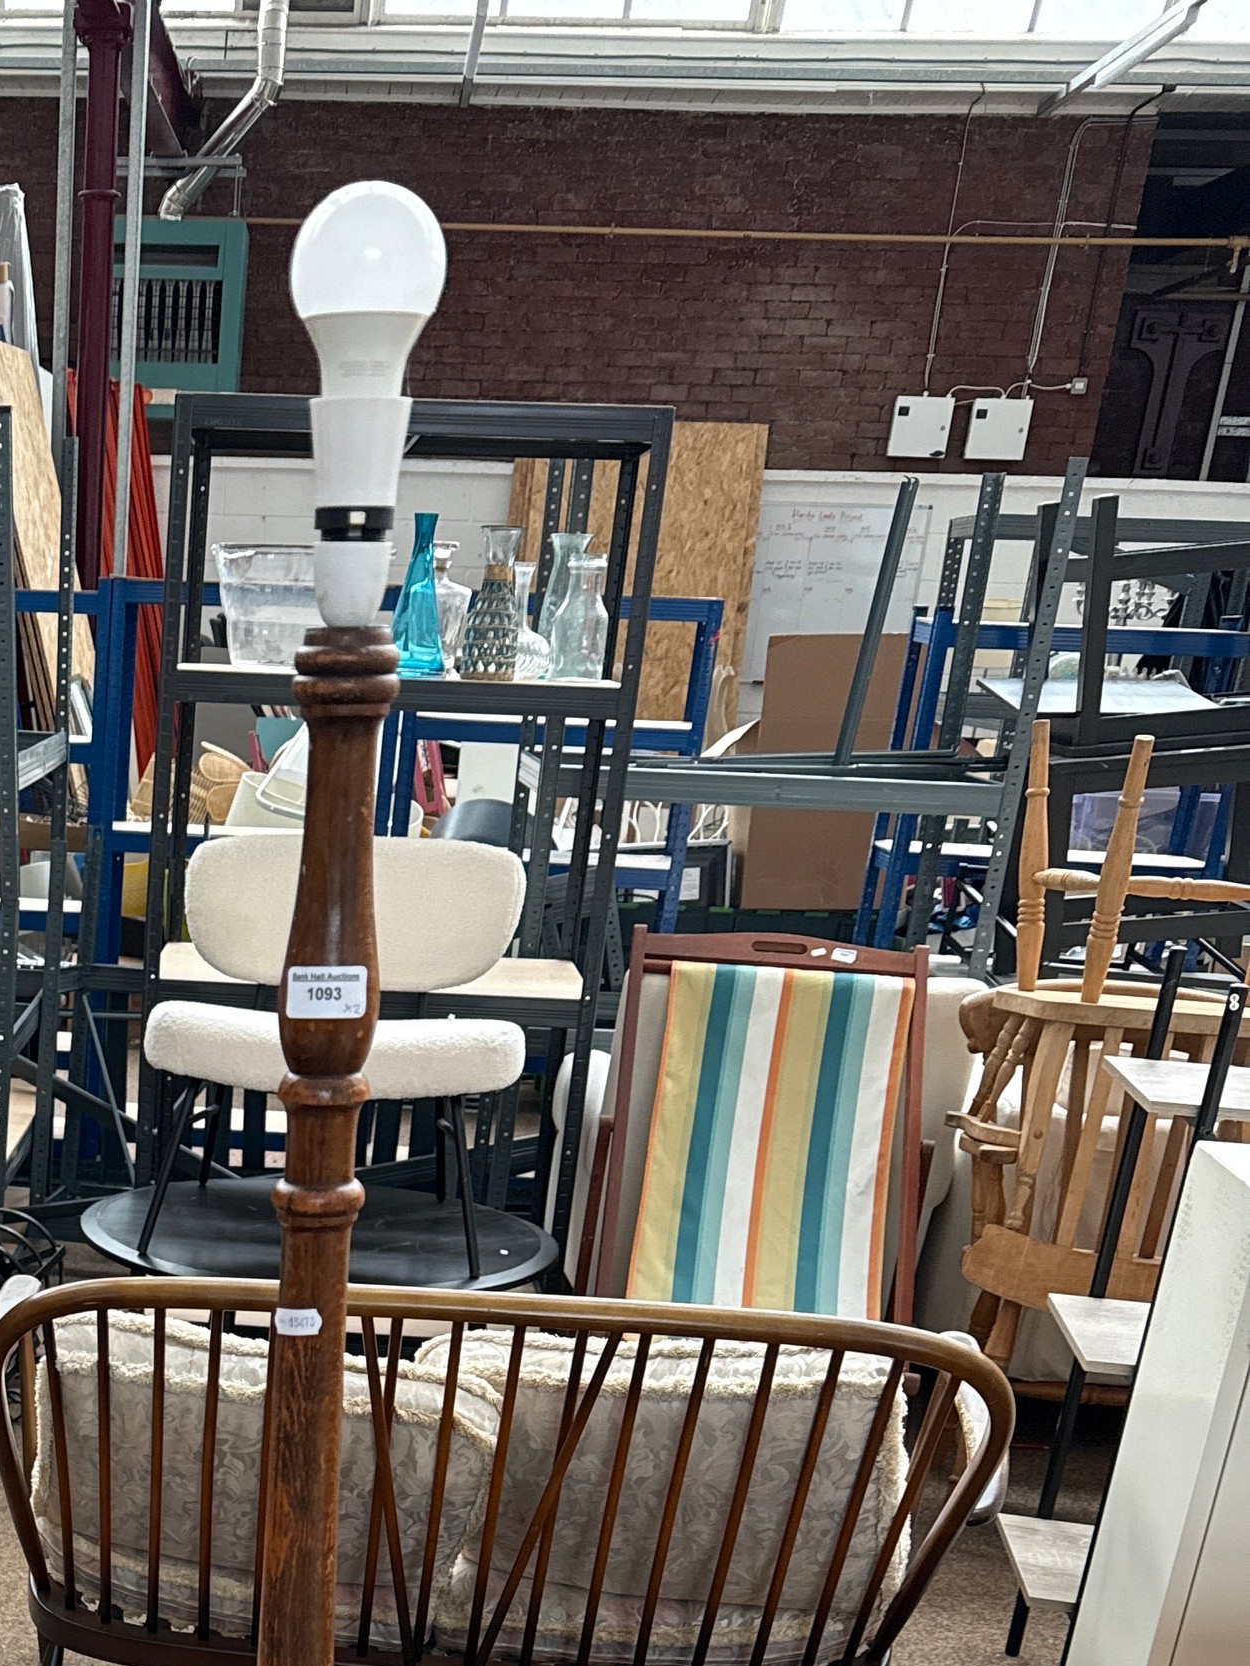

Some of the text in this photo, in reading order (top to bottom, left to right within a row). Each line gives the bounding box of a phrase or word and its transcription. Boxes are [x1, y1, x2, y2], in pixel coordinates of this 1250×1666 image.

[292, 973, 360, 981] Bank Hall Auctions
[307, 987, 342, 1001] 1093
